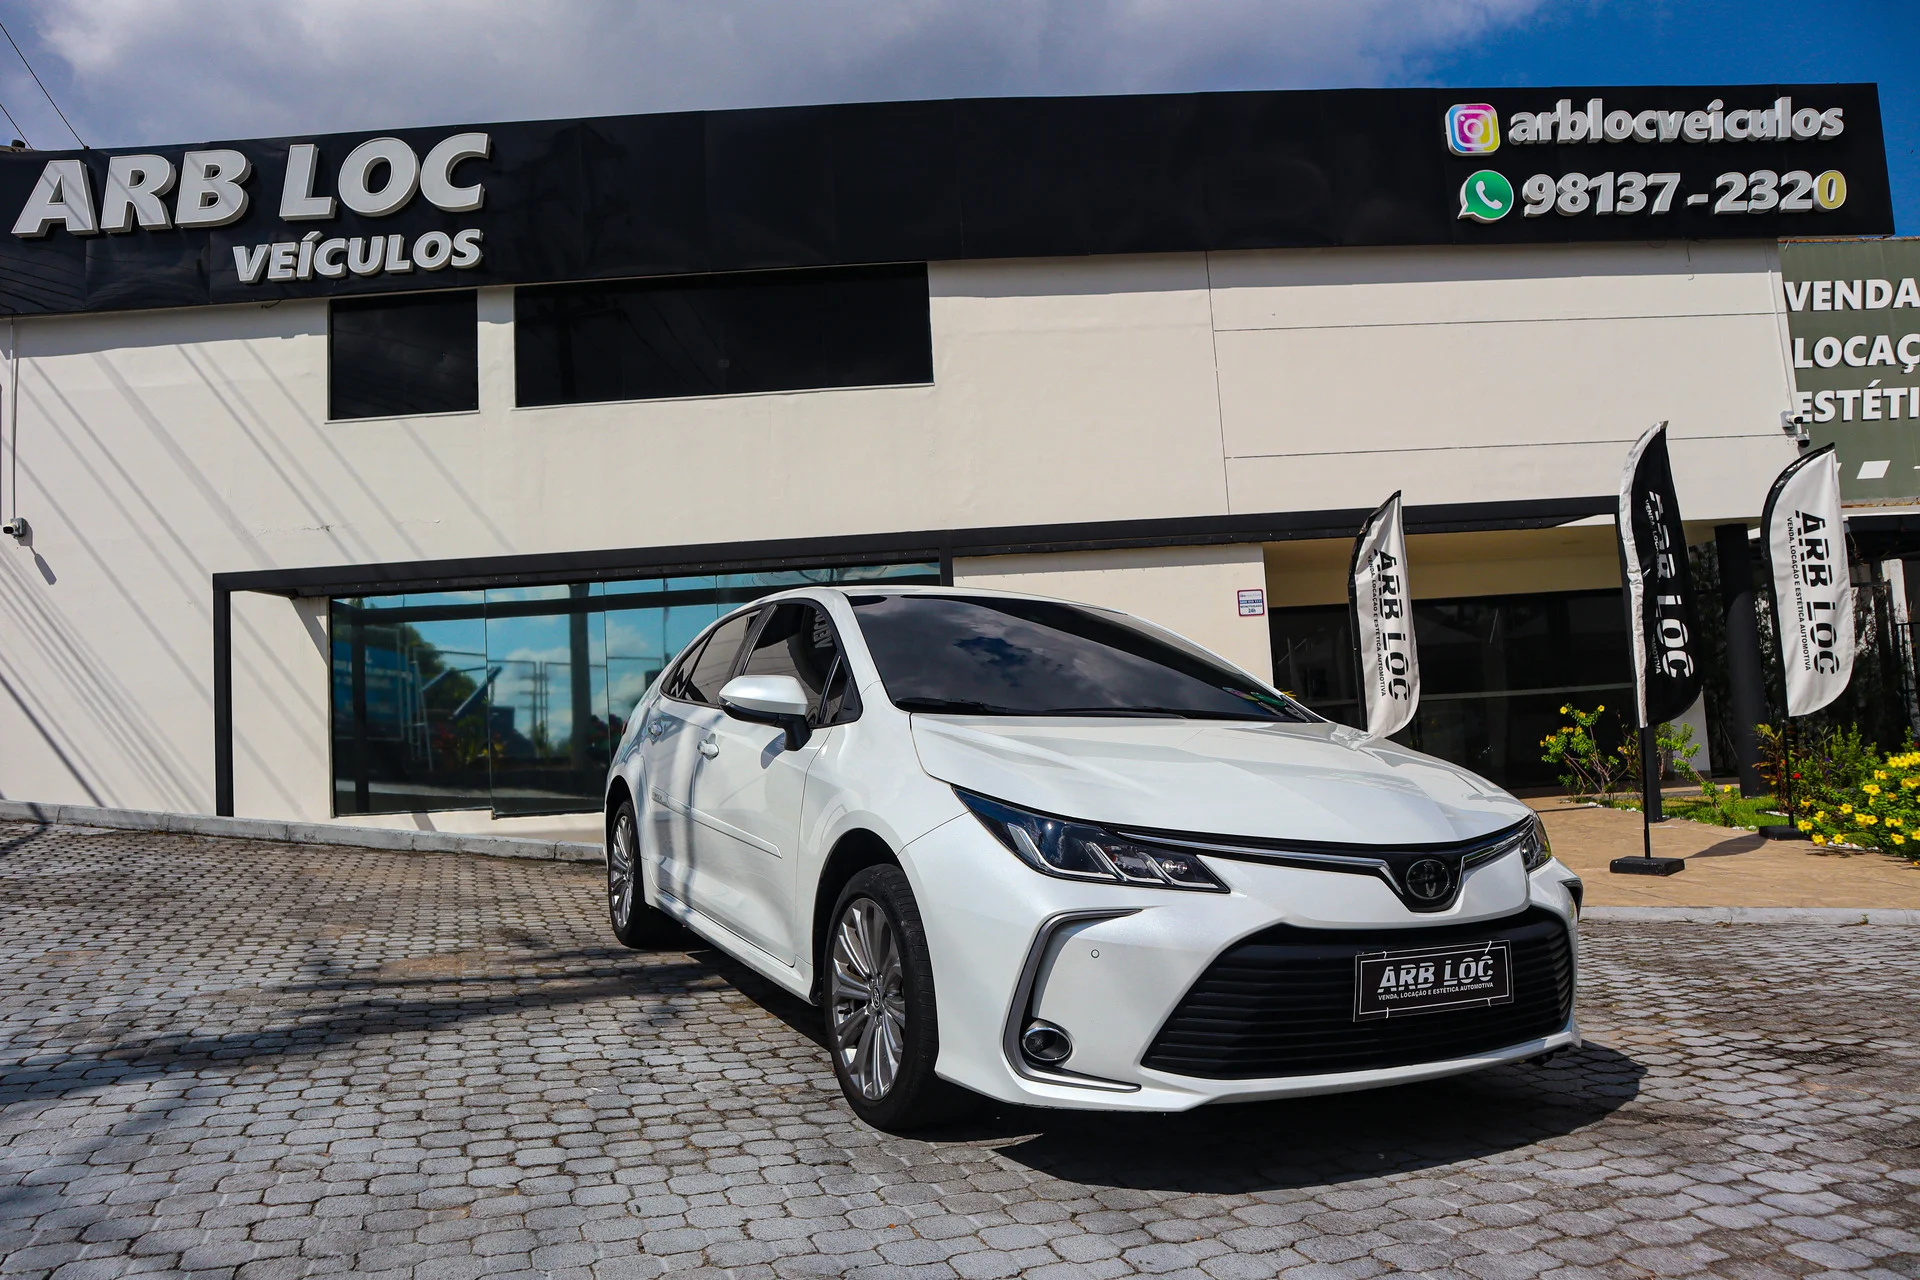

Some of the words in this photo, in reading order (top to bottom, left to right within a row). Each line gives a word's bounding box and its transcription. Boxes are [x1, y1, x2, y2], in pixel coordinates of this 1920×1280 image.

[1509, 96, 1845, 144] arblocveiculos
[11, 148, 253, 238] ARB
[279, 132, 493, 221] LOC
[233, 228, 485, 284] VEÍCULOS
[1784, 278, 1920, 312] VENDA
[1793, 333, 1920, 375] LOCAÇ
[1787, 516, 1795, 544] VENDA,
[1795, 509, 1833, 587] ARB
[1373, 548, 1404, 620] ARB
[1789, 545, 1800, 580] LOCAÇÃO
[1656, 594, 1694, 678] LOC
[1799, 624, 1811, 671] AUTOMOTIVA
[1806, 601, 1840, 675] LOC
[1377, 652, 1387, 697] AUTOMOTIVA
[1382, 632, 1411, 701] LOC
[1377, 962, 1435, 993] ARB
[1443, 955, 1494, 986] LOC
[1378, 993, 1400, 1001] VENDA,
[1400, 990, 1427, 998] LOCAÇÃO
[1460, 982, 1494, 991] AUTOMOTIVA
